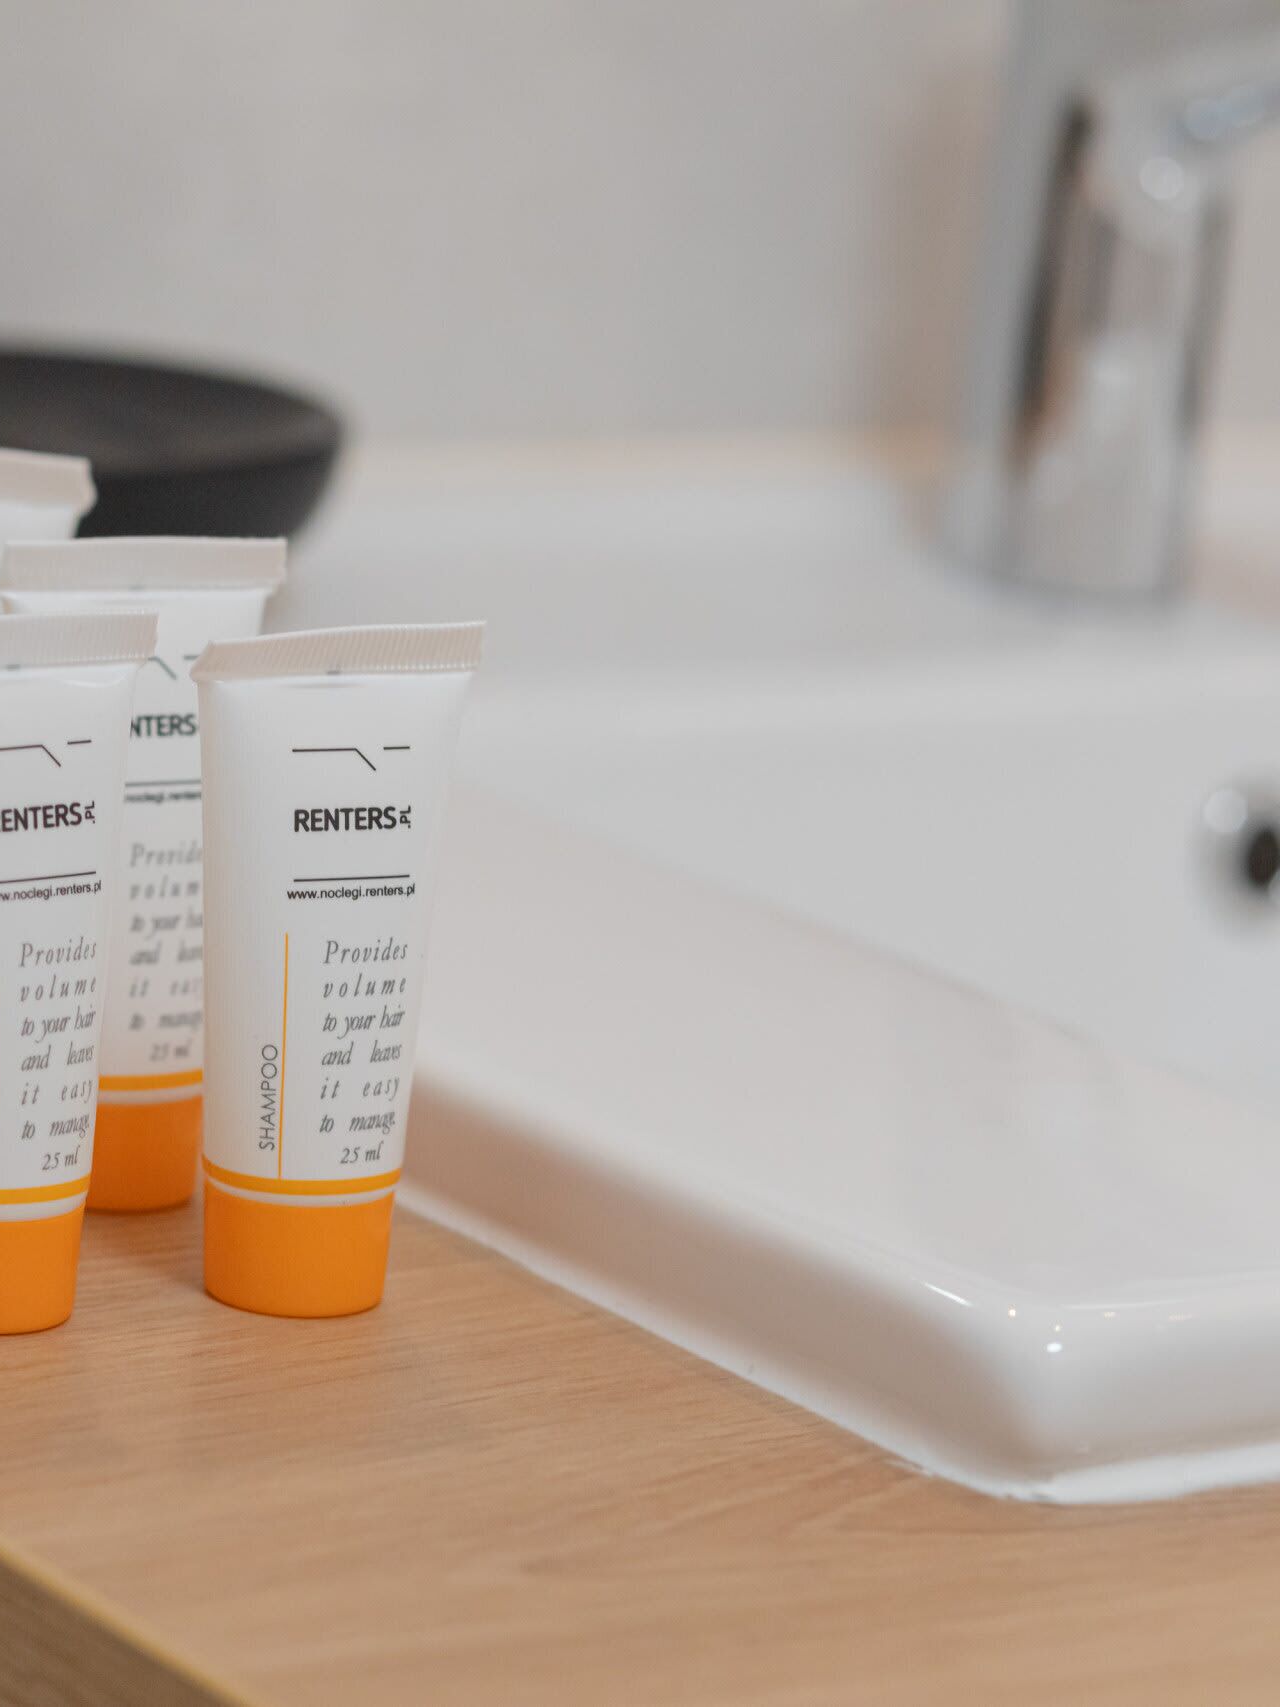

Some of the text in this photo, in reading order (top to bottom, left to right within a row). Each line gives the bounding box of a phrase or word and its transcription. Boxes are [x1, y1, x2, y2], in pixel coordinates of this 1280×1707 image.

[294, 806, 397, 833] RENTERS
[287, 883, 416, 901] www.noclegi.renters.pl
[19, 936, 97, 968] Provides
[324, 937, 408, 965] Provides
[20, 973, 97, 1002] volume
[323, 973, 407, 999] volume
[21, 1005, 96, 1043] to your hair
[322, 1004, 406, 1039] to your hair
[21, 1042, 95, 1072] and leaves
[321, 1039, 403, 1066] and leaves
[21, 1079, 93, 1106] it easy
[259, 1044, 279, 1151] SHAMPOO
[320, 1075, 401, 1102] it easy
[21, 1119, 36, 1141] to
[320, 1114, 335, 1133] to
[42, 1145, 81, 1171] 25 ml
[340, 1140, 385, 1165] 25 ml
